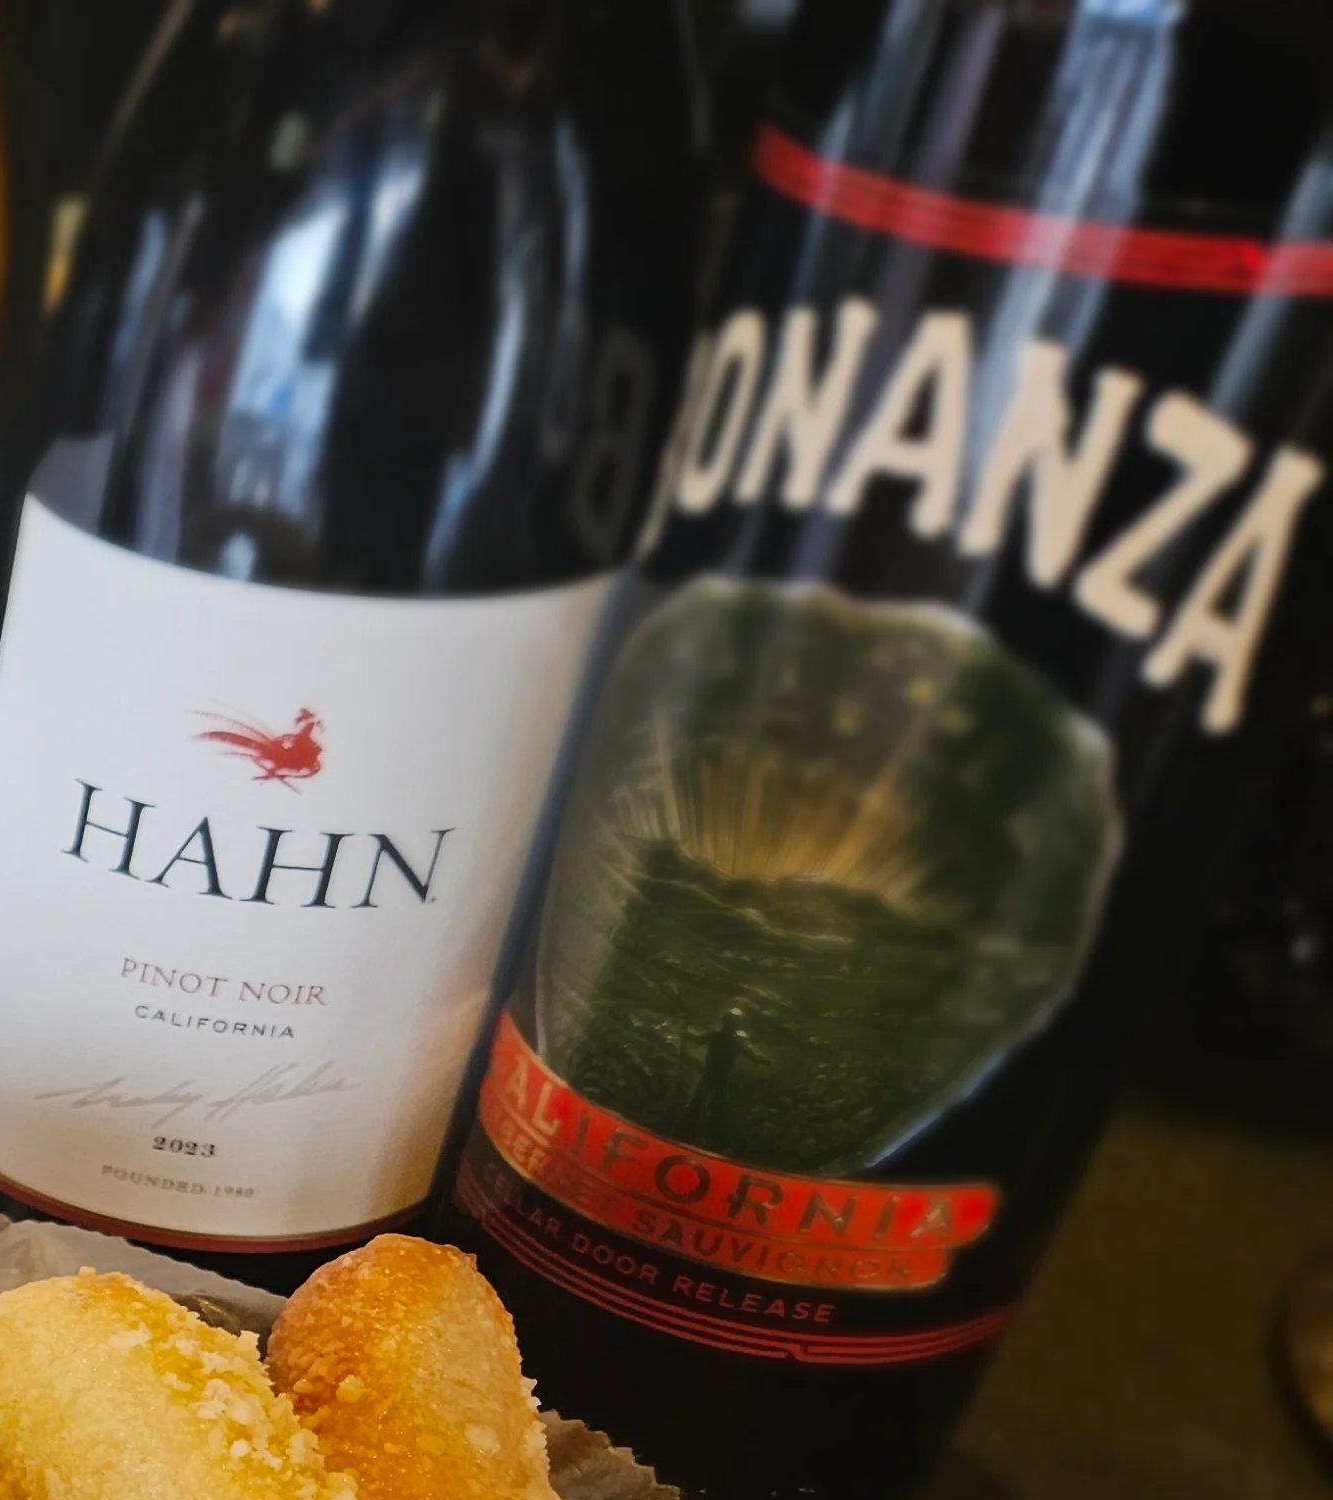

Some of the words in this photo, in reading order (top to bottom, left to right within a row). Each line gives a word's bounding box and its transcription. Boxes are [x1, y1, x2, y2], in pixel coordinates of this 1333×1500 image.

[633, 296, 1327, 736] ONANZA
[60, 778, 458, 910] HAHN
[120, 957, 228, 998] PINOT
[238, 981, 328, 1007] NOIR
[134, 1005, 295, 1039] CALIFORNIA
[101, 1164, 204, 1196] FOUNDED
[151, 1136, 217, 1158] 2023
[505, 1053, 953, 1240] ALIFORNIA
[572, 1227, 660, 1285] DOOR
[672, 1275, 835, 1323] RELEASE
[634, 1207, 912, 1279] SAUVIGNON
